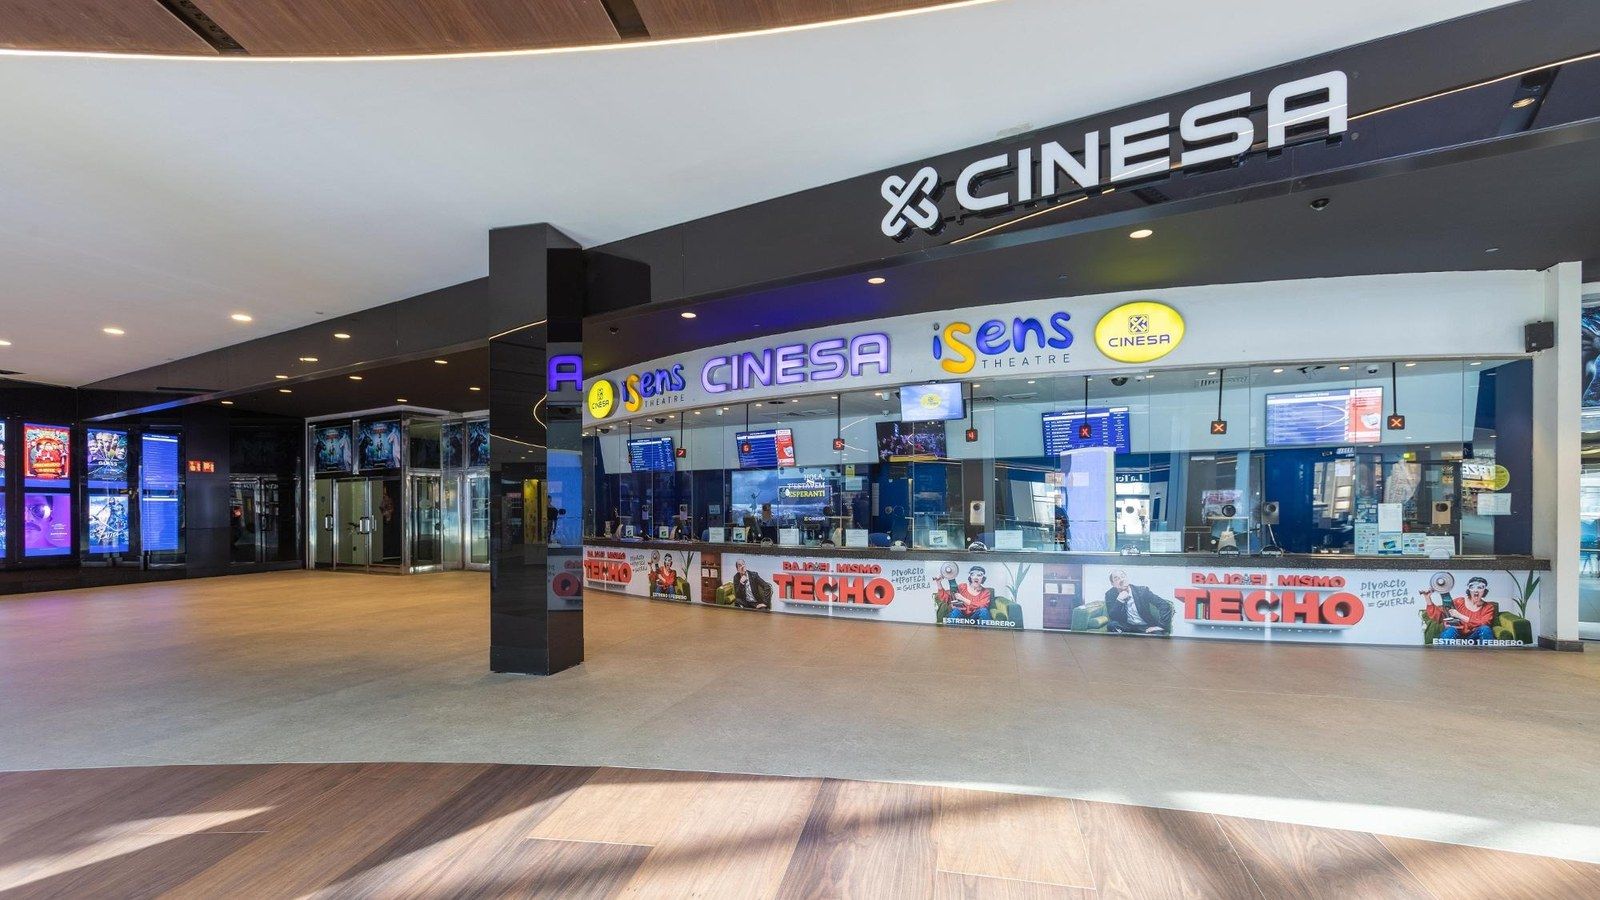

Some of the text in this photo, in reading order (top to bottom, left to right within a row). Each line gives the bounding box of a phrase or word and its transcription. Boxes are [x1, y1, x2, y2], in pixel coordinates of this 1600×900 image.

[955, 70, 1348, 211] CINESA
[932, 311, 1073, 374] iSens
[1108, 334, 1170, 348] CINESA
[701, 333, 891, 393] CINESA
[982, 353, 1070, 369] THEATRE
[621, 363, 686, 412] iSens
[645, 394, 685, 408] THEATRE
[584, 559, 632, 584] TECHO
[836, 563, 882, 574] MISMO
[1191, 572, 1245, 585] BAJO
[1278, 574, 1346, 588] MISMO
[1360, 579, 1406, 591] DIVORCIO
[773, 573, 895, 606] TECHO
[1174, 588, 1365, 625] TECHO
[1377, 597, 1415, 608] GUERRA
[942, 617, 976, 625] ESTRENO
[981, 619, 1015, 627] FEBRERO
[1432, 638, 1475, 646] ESTRENO
